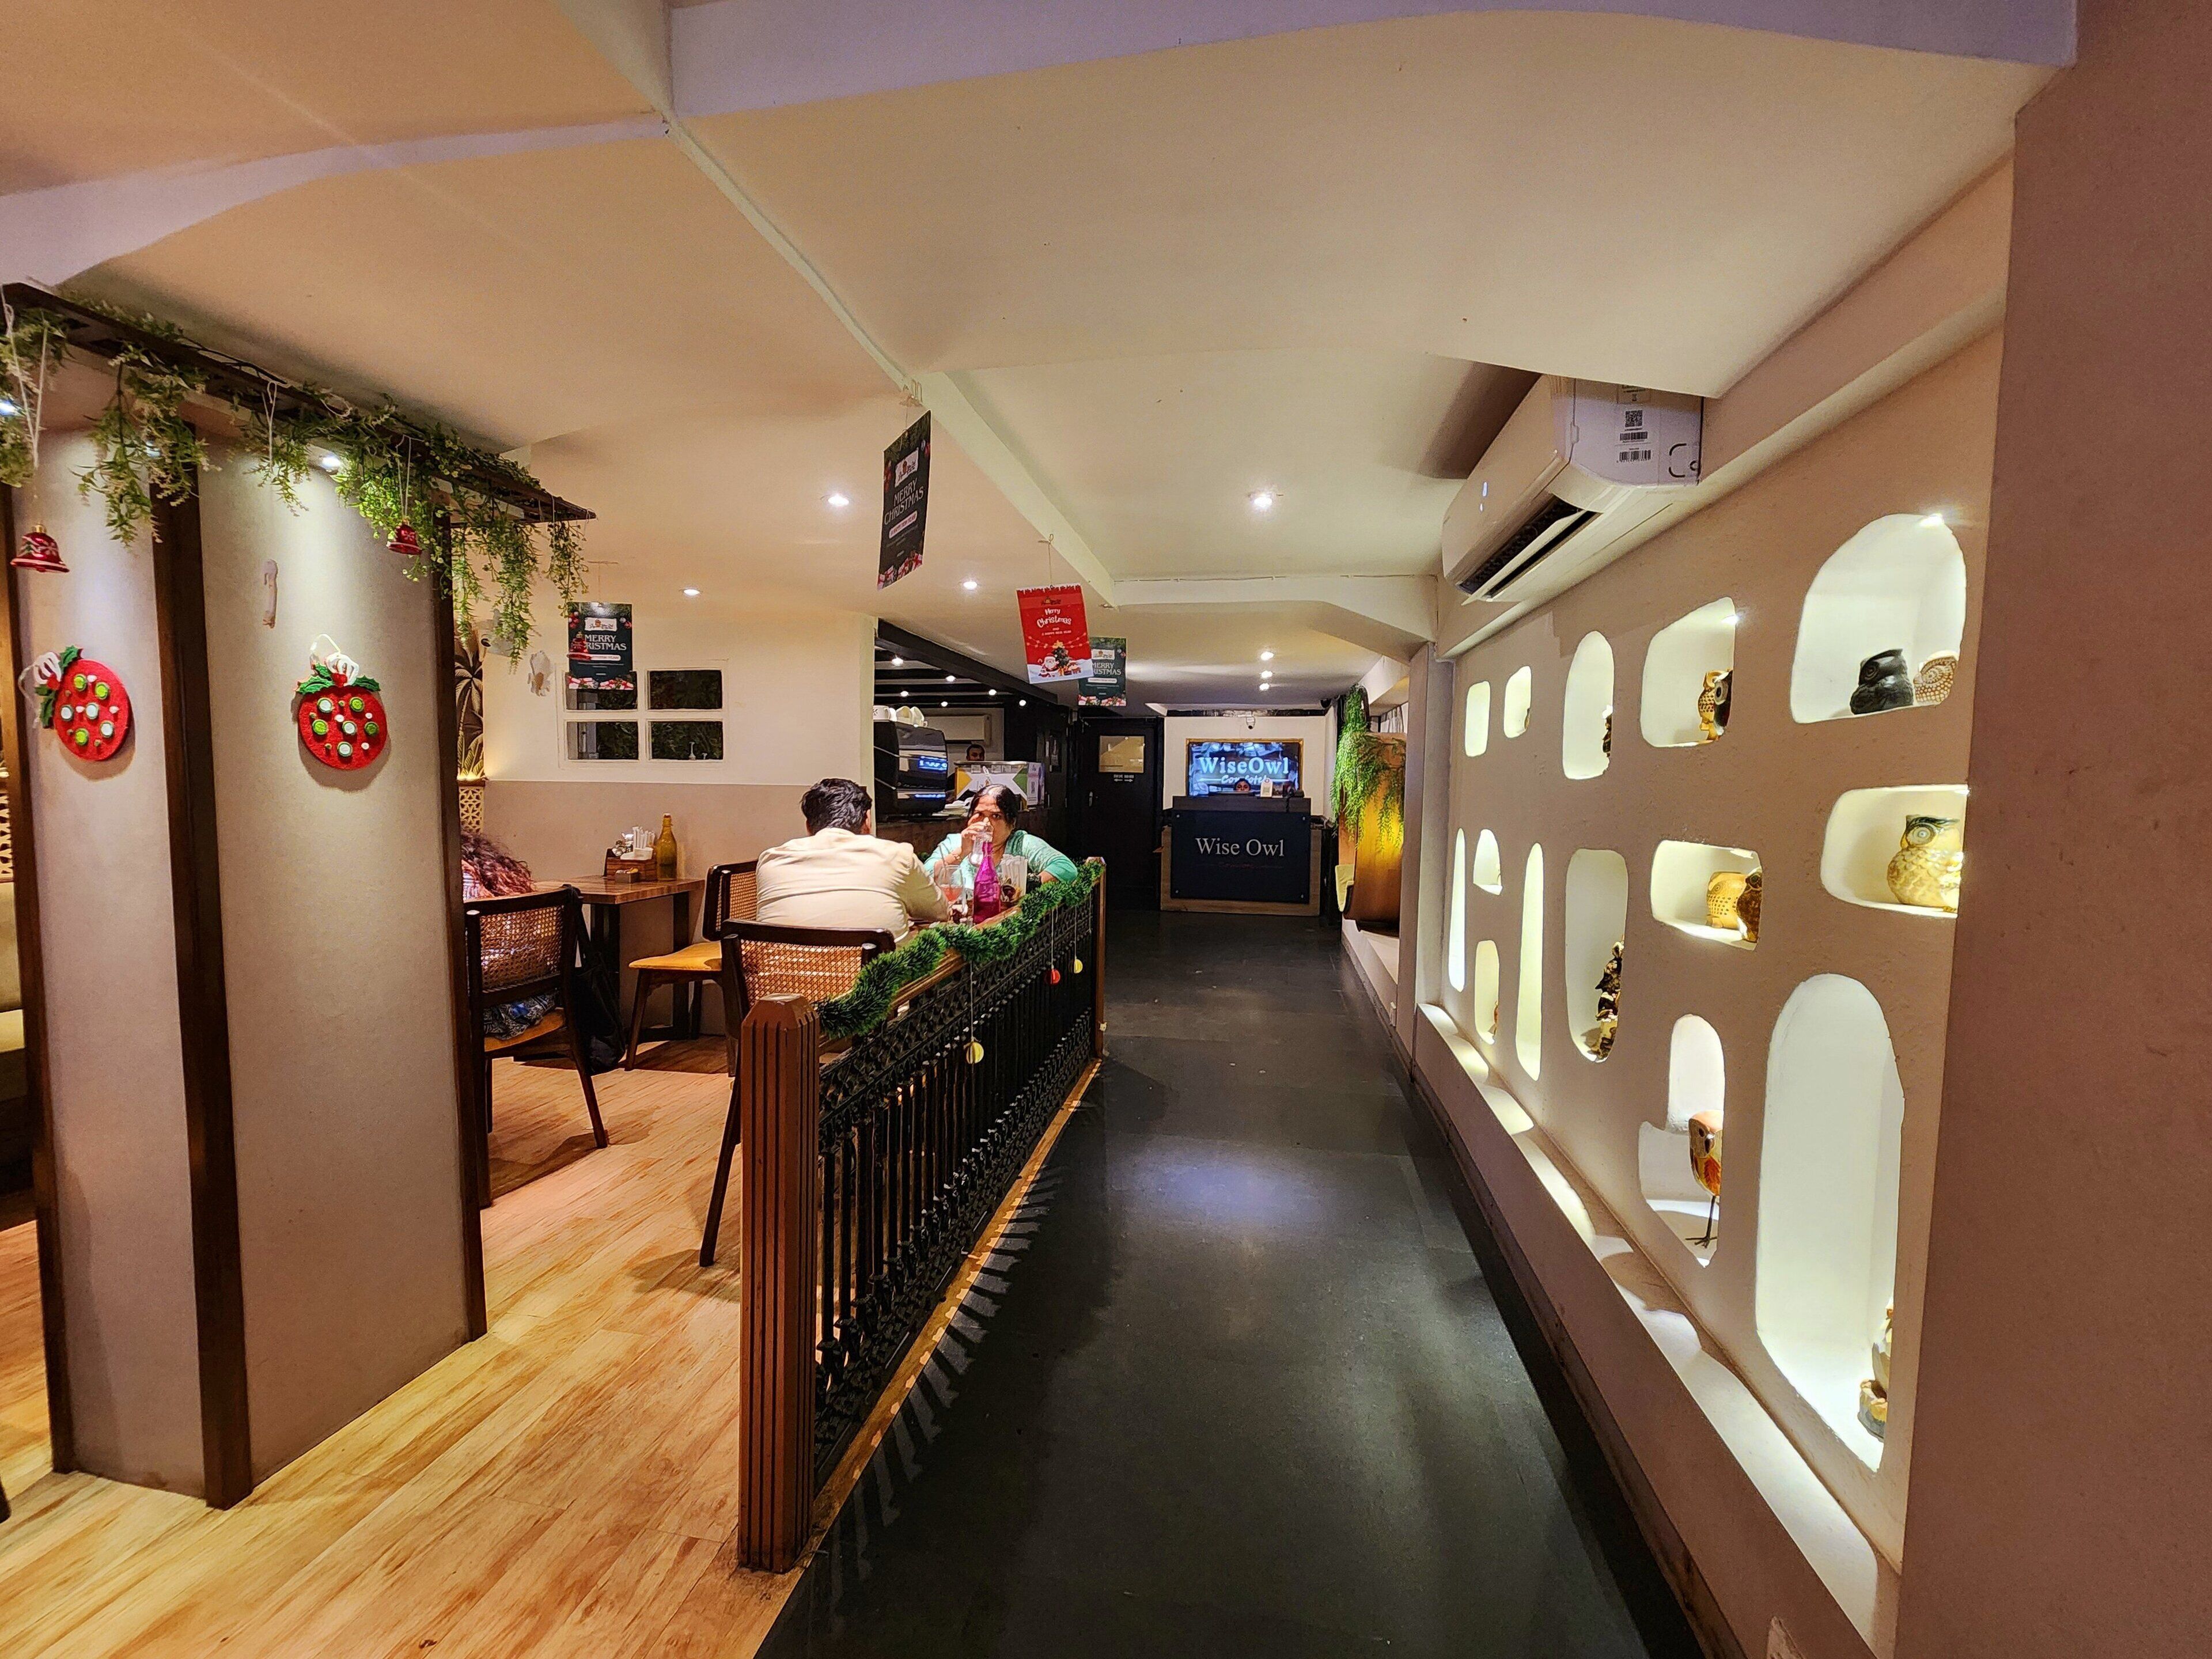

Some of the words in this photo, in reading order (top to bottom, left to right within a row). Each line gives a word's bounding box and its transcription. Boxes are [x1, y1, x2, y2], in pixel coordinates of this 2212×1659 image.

[893, 478, 918, 507] MERRY
[884, 486, 923, 525] CHRISTMAS
[1037, 615, 1071, 628] Christmas
[584, 634, 616, 642] MERRY
[586, 642, 627, 650] RISTMAS
[1195, 838, 1240, 855] Wise
[1246, 839, 1284, 857] Owl
